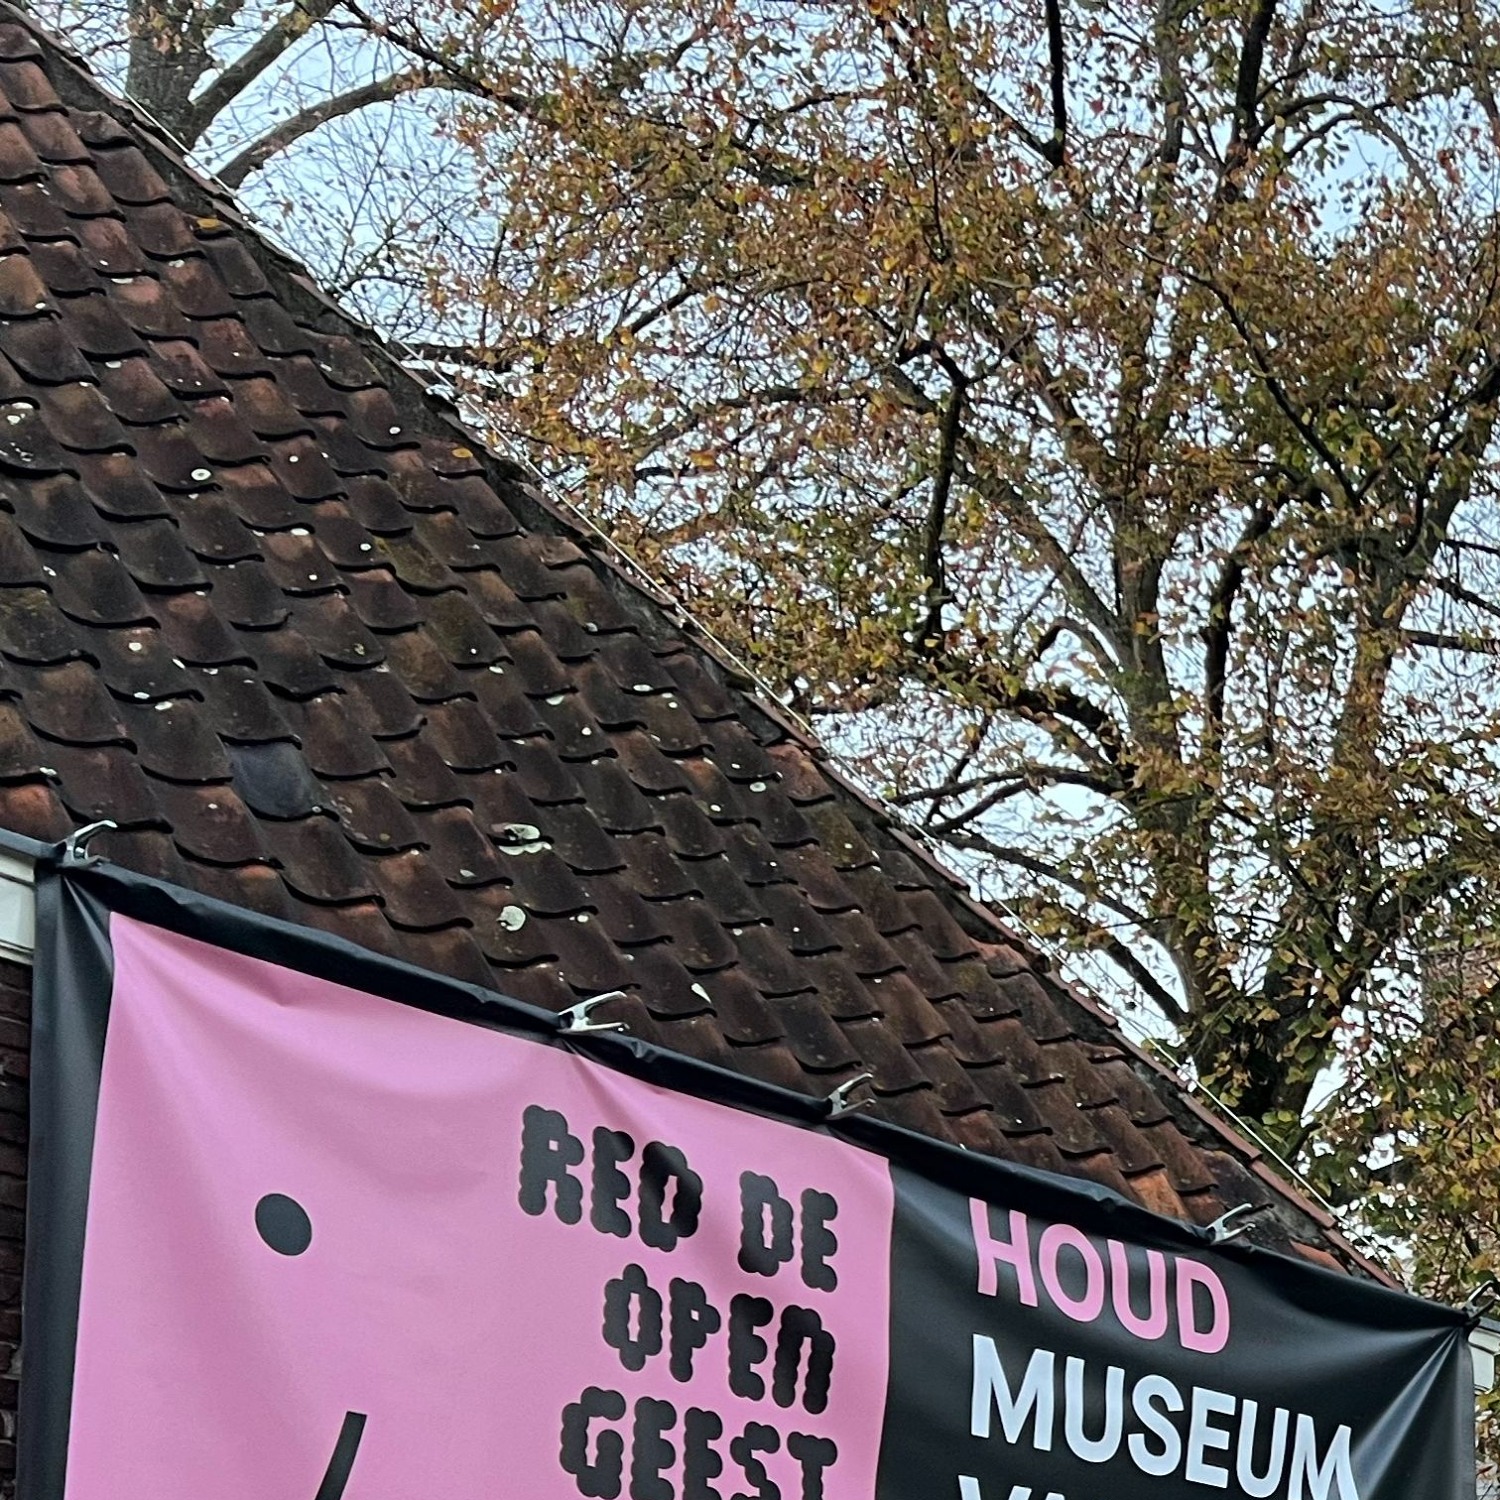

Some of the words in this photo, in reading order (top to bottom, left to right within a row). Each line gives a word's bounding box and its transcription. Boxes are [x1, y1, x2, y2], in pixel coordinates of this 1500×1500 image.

[518, 1105, 704, 1252] RED
[738, 1170, 838, 1293] DE
[969, 1197, 1230, 1354] HOUD
[603, 1263, 836, 1414] OPEN
